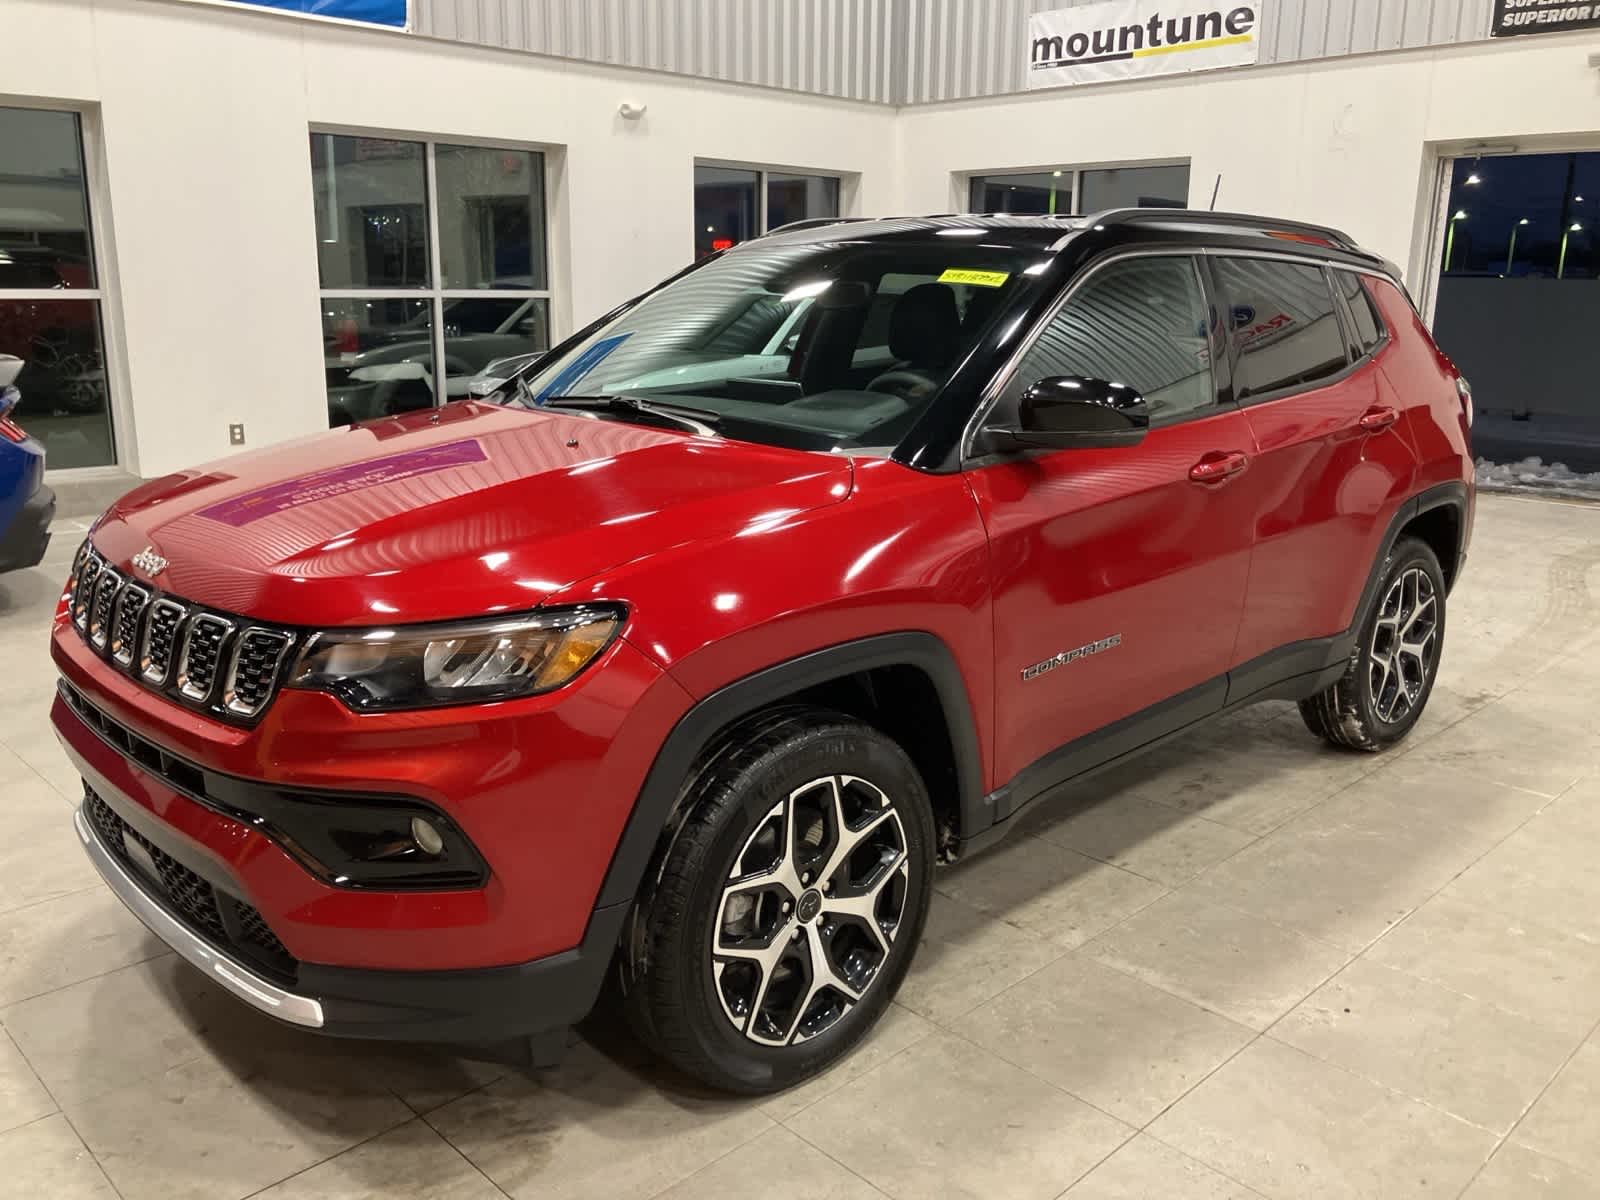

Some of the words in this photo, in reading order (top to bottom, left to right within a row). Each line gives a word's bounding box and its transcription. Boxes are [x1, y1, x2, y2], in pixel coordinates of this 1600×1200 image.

[1031, 7, 1256, 62] mountune
[1502, 7, 1592, 26] SUPERIOR
[1021, 633, 1122, 681] COMPASS
